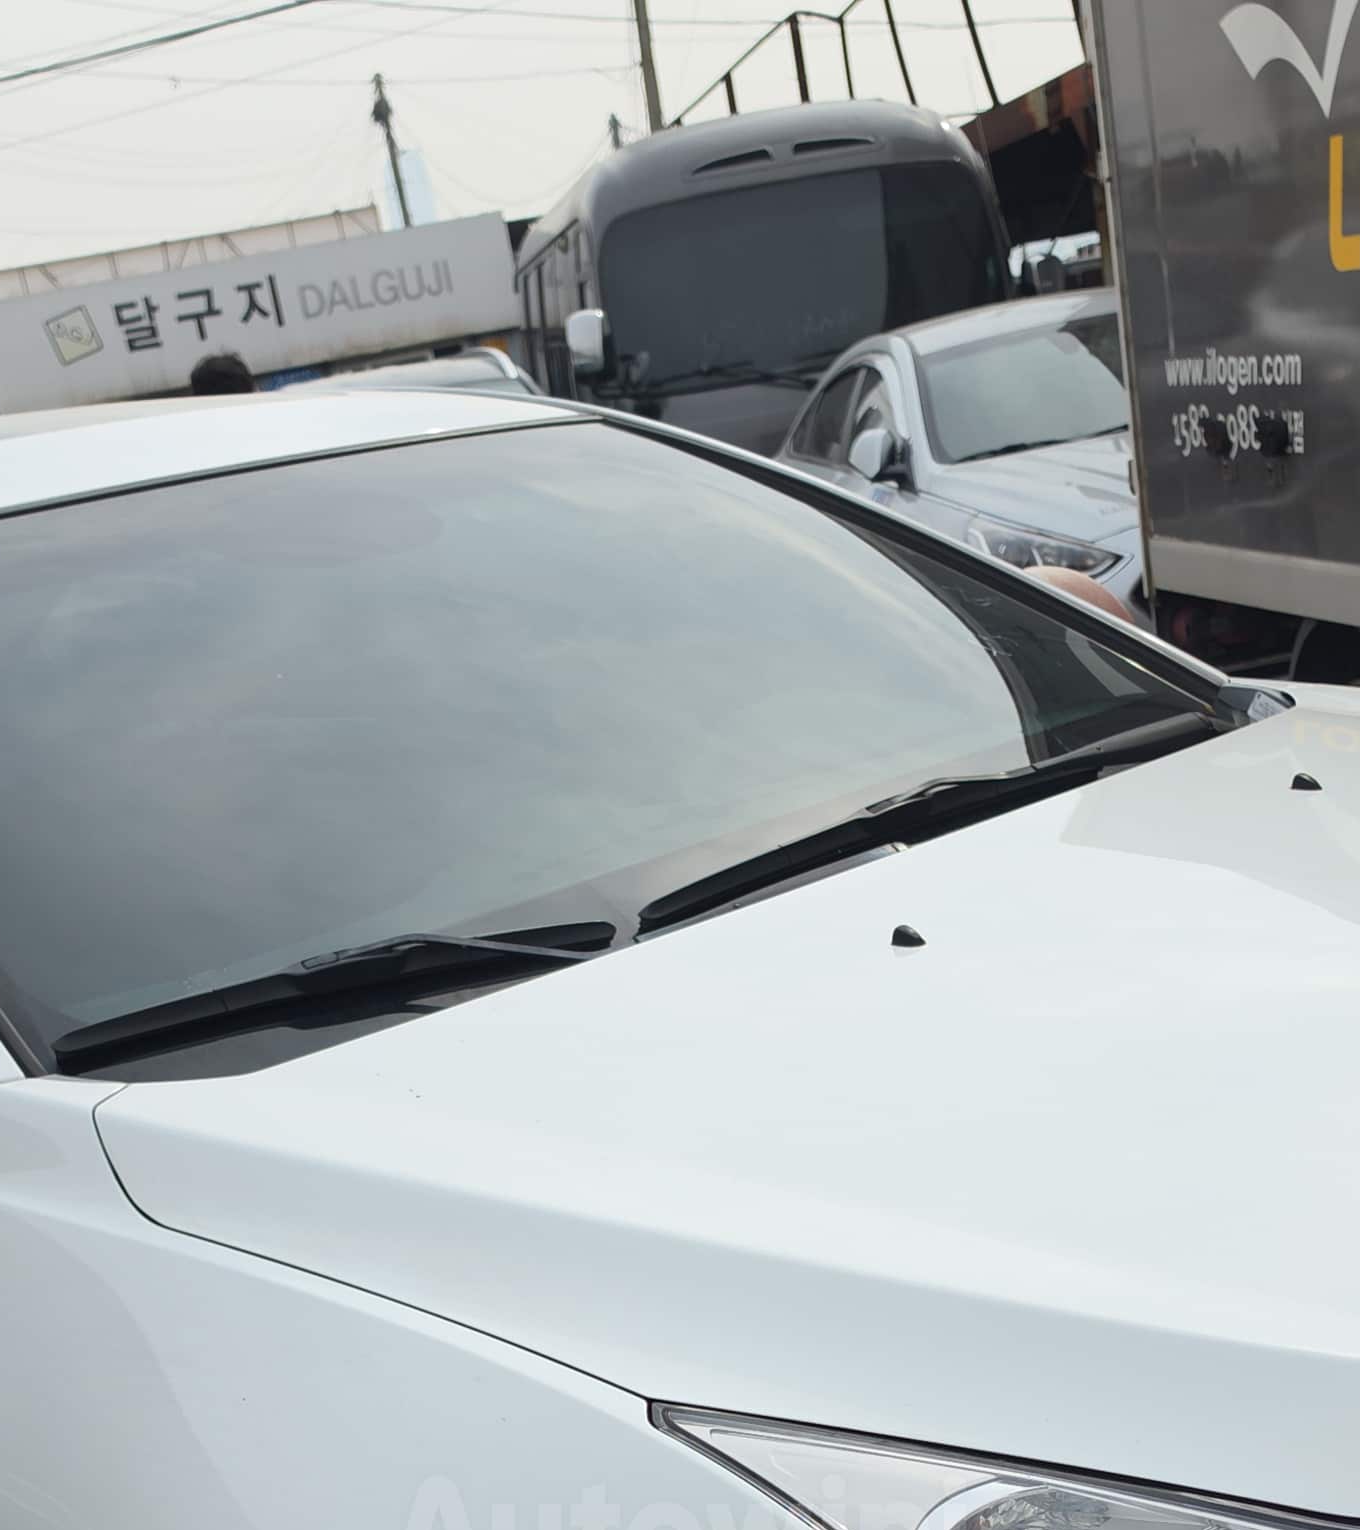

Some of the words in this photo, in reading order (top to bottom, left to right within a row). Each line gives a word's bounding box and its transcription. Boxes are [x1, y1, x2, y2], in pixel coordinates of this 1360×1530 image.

[112, 273, 287, 353] 달구지
[296, 259, 455, 321] DALGUJI
[1164, 347, 1302, 395] www.ilogen.com
